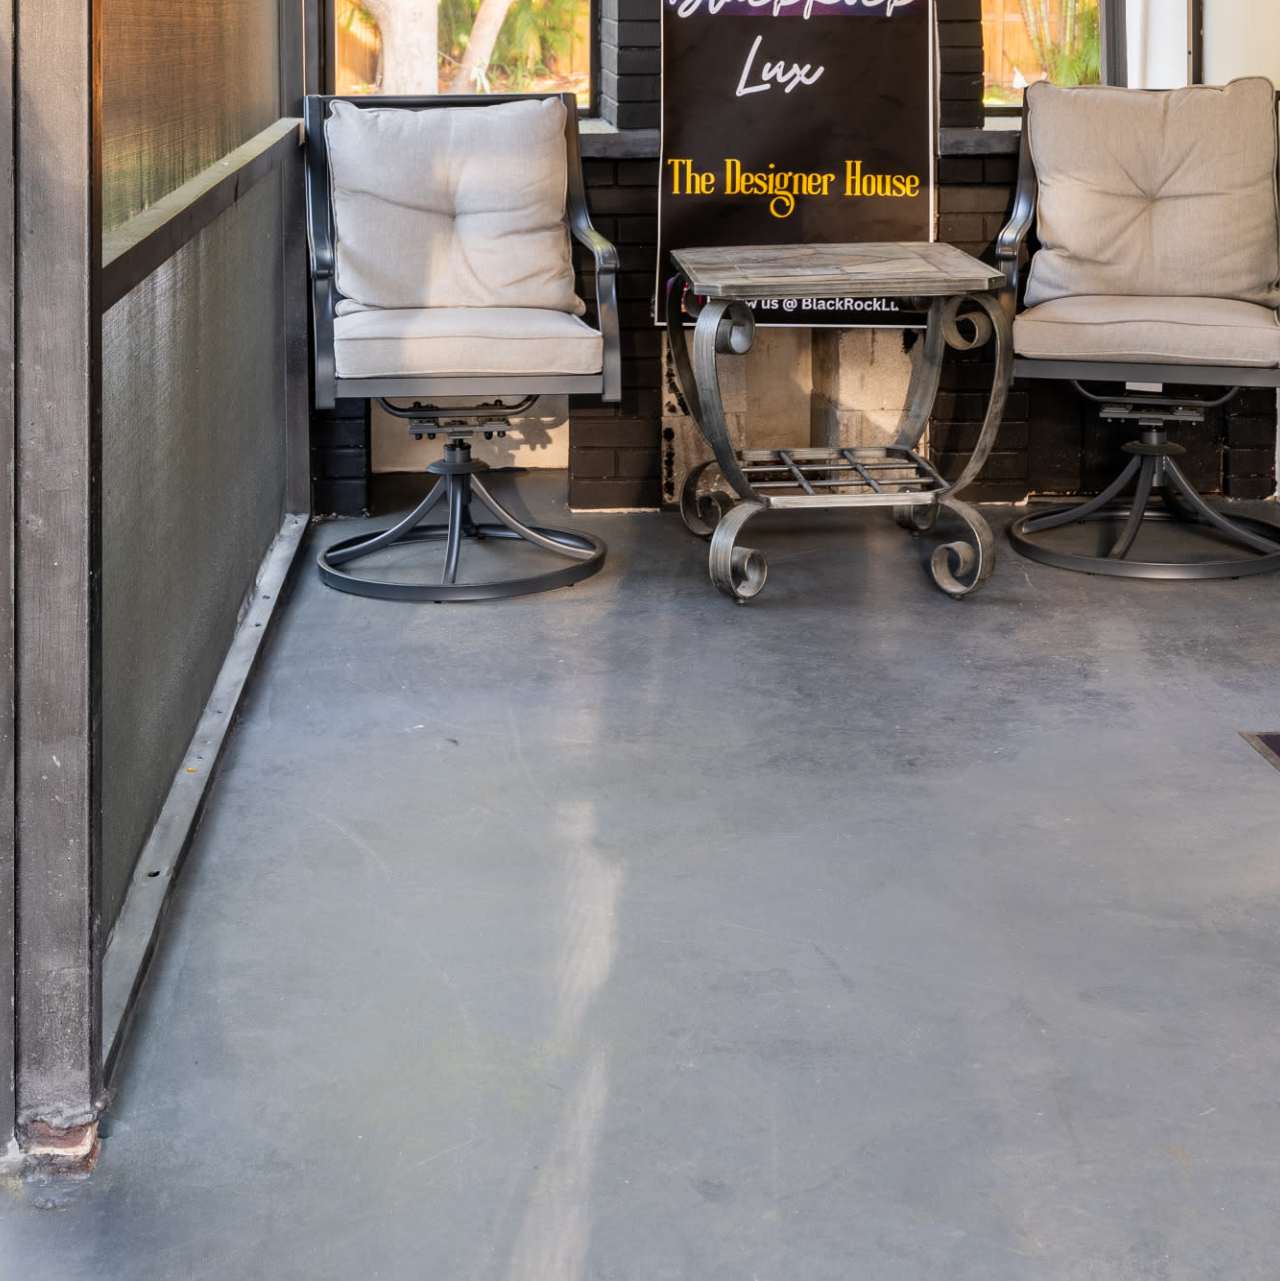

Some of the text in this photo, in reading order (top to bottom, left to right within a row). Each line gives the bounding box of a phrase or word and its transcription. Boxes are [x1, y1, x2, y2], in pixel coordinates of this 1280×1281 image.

[735, 35, 825, 97] Lux
[668, 159, 920, 218] The Designer House
[761, 299, 779, 310] us
[782, 298, 798, 312] @
